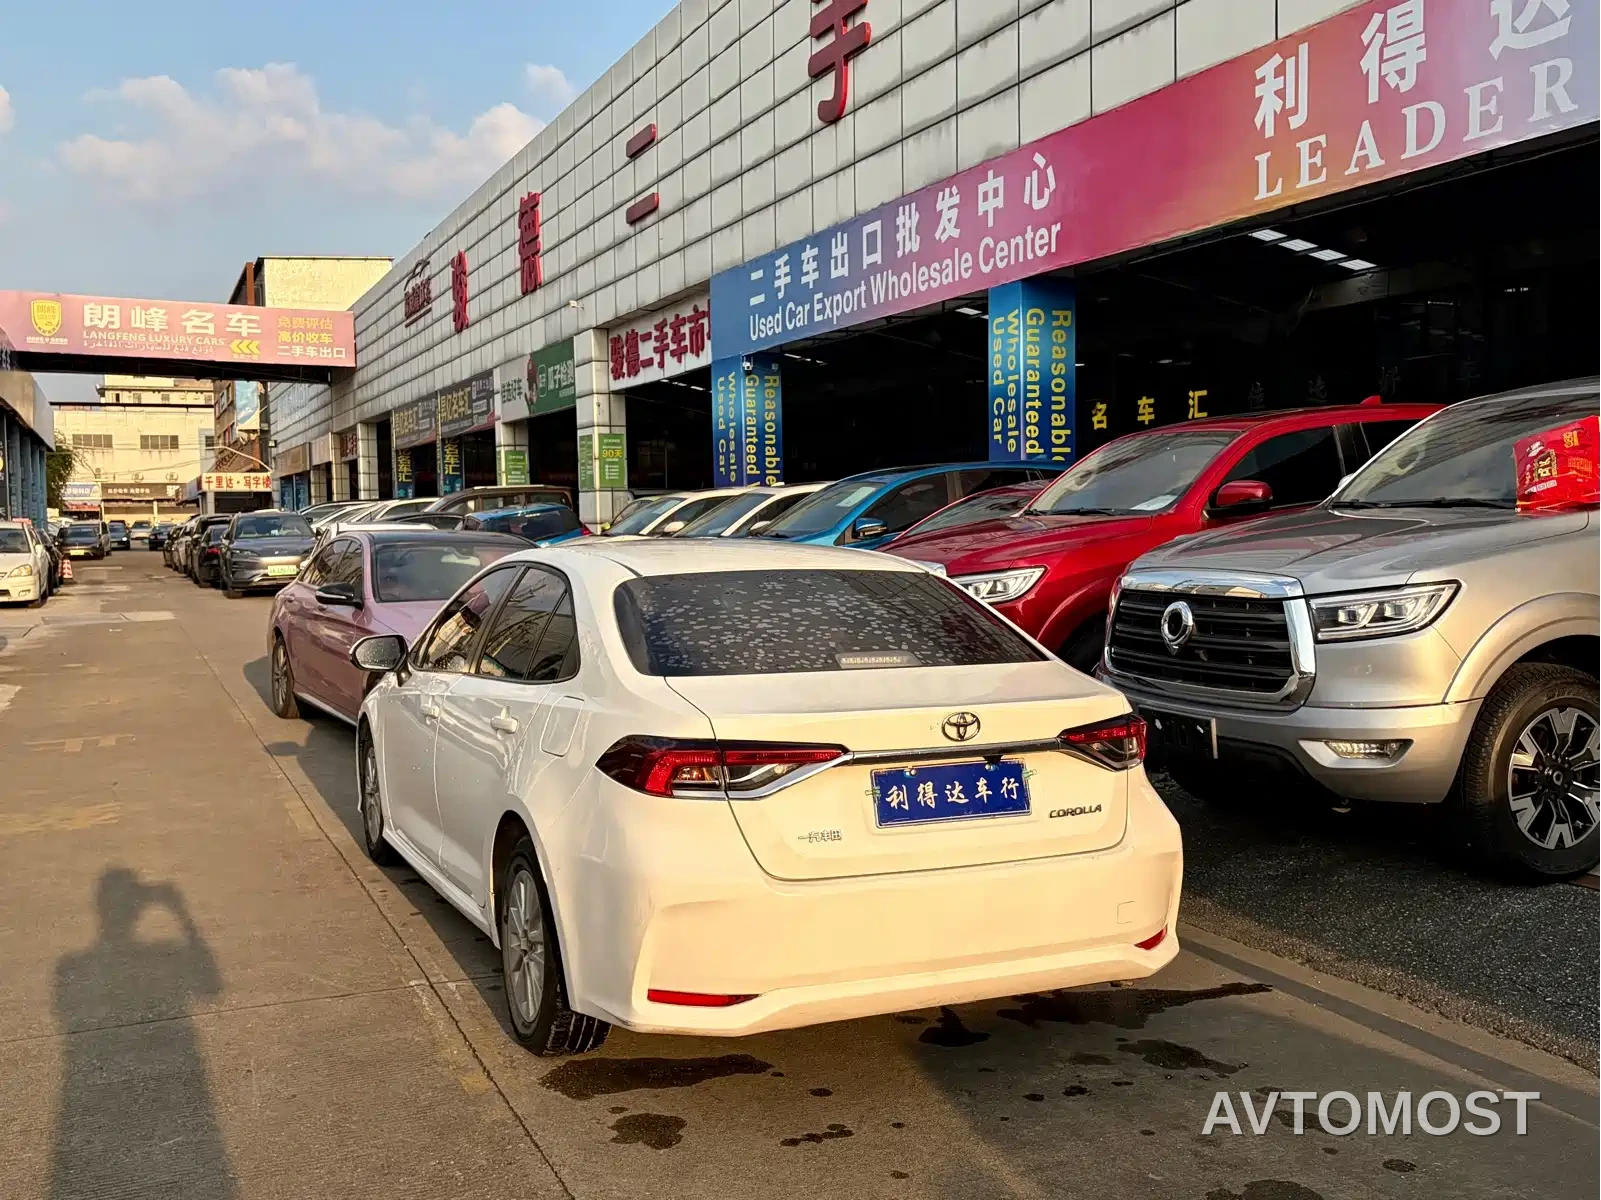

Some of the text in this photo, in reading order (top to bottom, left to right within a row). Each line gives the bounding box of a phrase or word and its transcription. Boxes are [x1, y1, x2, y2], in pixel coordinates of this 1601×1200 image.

[1254, 0, 1573, 138] 利得达
[1254, 57, 1578, 200] LEADER
[750, 152, 1056, 306] 二手车出口批发中心
[83, 302, 262, 337] 朗峰名车
[750, 222, 1061, 341] Used Car Export Wholesale Center
[83, 331, 225, 346] LANGFENG LUXURY CARS
[277, 316, 333, 330] 免费评估
[277, 346, 346, 359] 二手车出口
[278, 331, 333, 345] 高价收车
[610, 304, 711, 381] 骏德二手车市
[717, 377, 726, 430] Used
[993, 317, 1004, 444] Used Car
[1007, 309, 1019, 453] Wholesale
[1025, 308, 1044, 454] Guaranteed
[1092, 390, 1208, 430] 名车汇
[728, 371, 737, 483] Wholesale
[745, 374, 760, 475] Guaranteed
[764, 375, 780, 486] Reasonable
[886, 777, 1020, 810] 利得达车行
[1049, 803, 1103, 819] COROLLA
[798, 829, 842, 843] 一汽丰田
